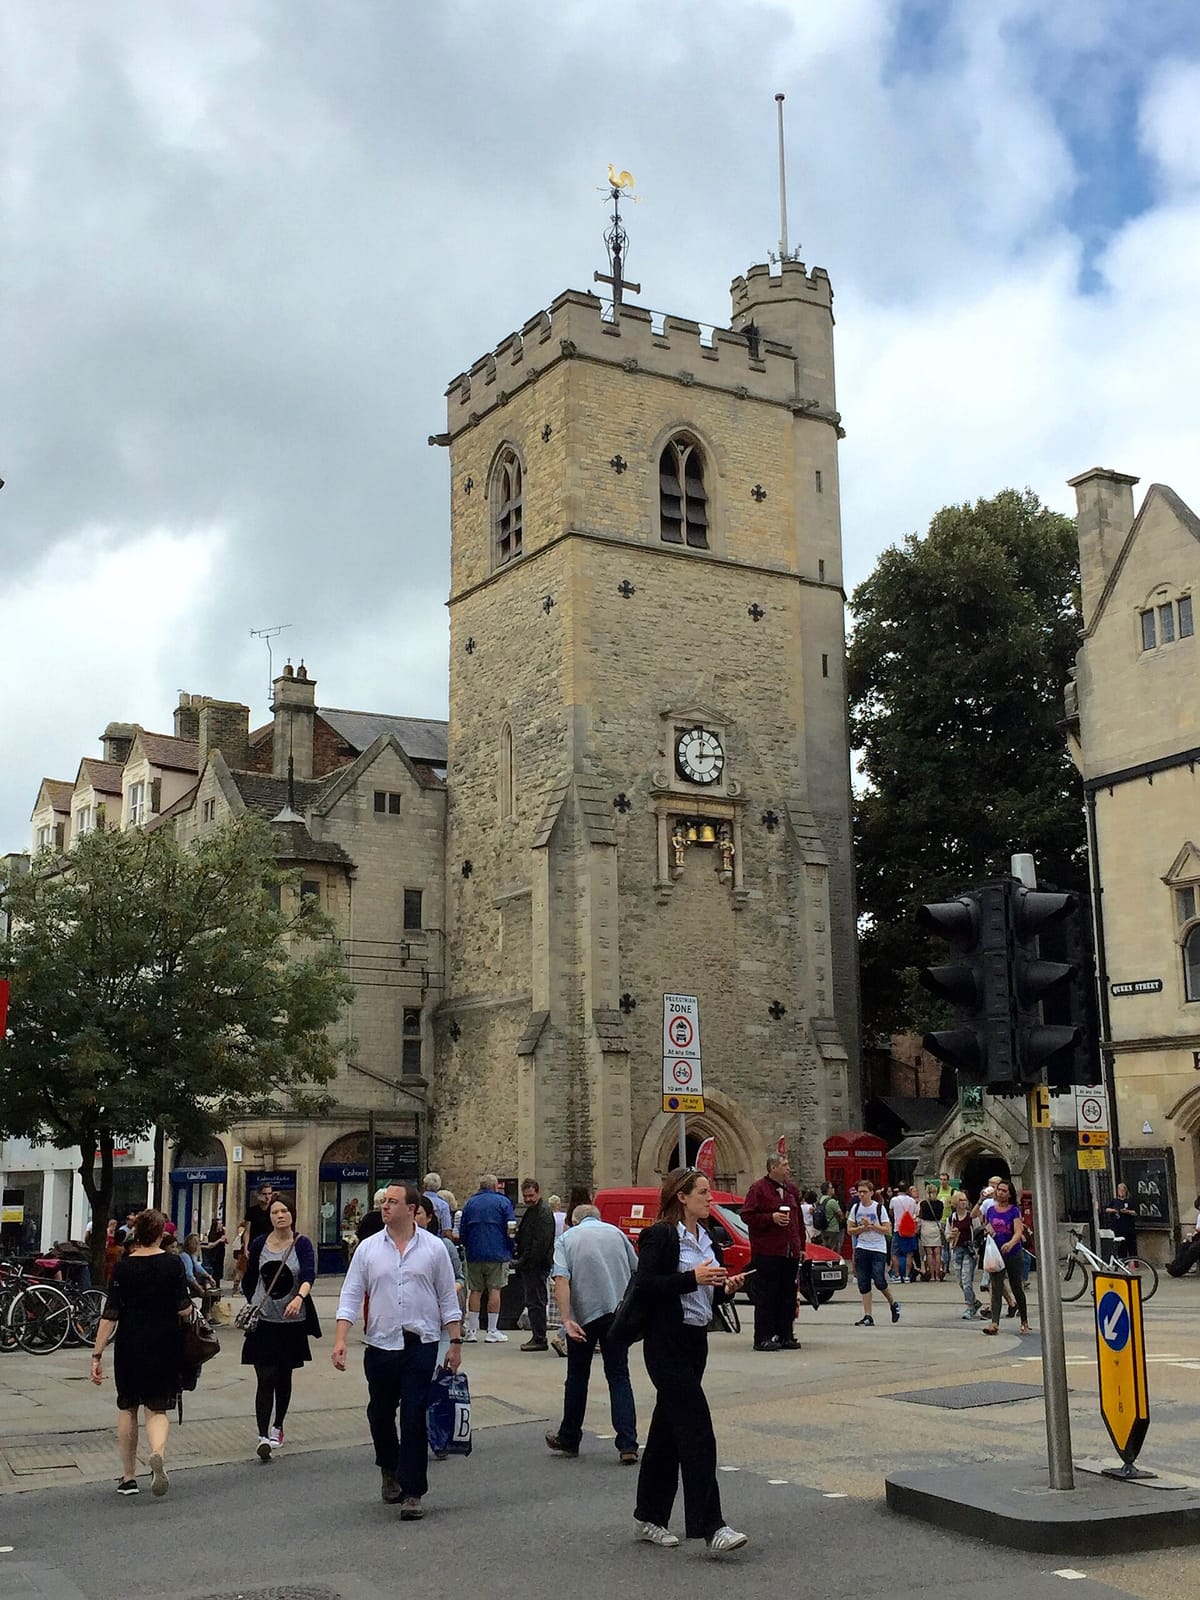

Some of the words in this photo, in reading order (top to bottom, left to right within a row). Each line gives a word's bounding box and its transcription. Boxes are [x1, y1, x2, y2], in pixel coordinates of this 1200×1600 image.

[1113, 985, 1132, 994] QUEEN
[1135, 982, 1159, 990] STREET
[669, 1003, 692, 1014] ZONE
[458, 1408, 470, 1437] B
